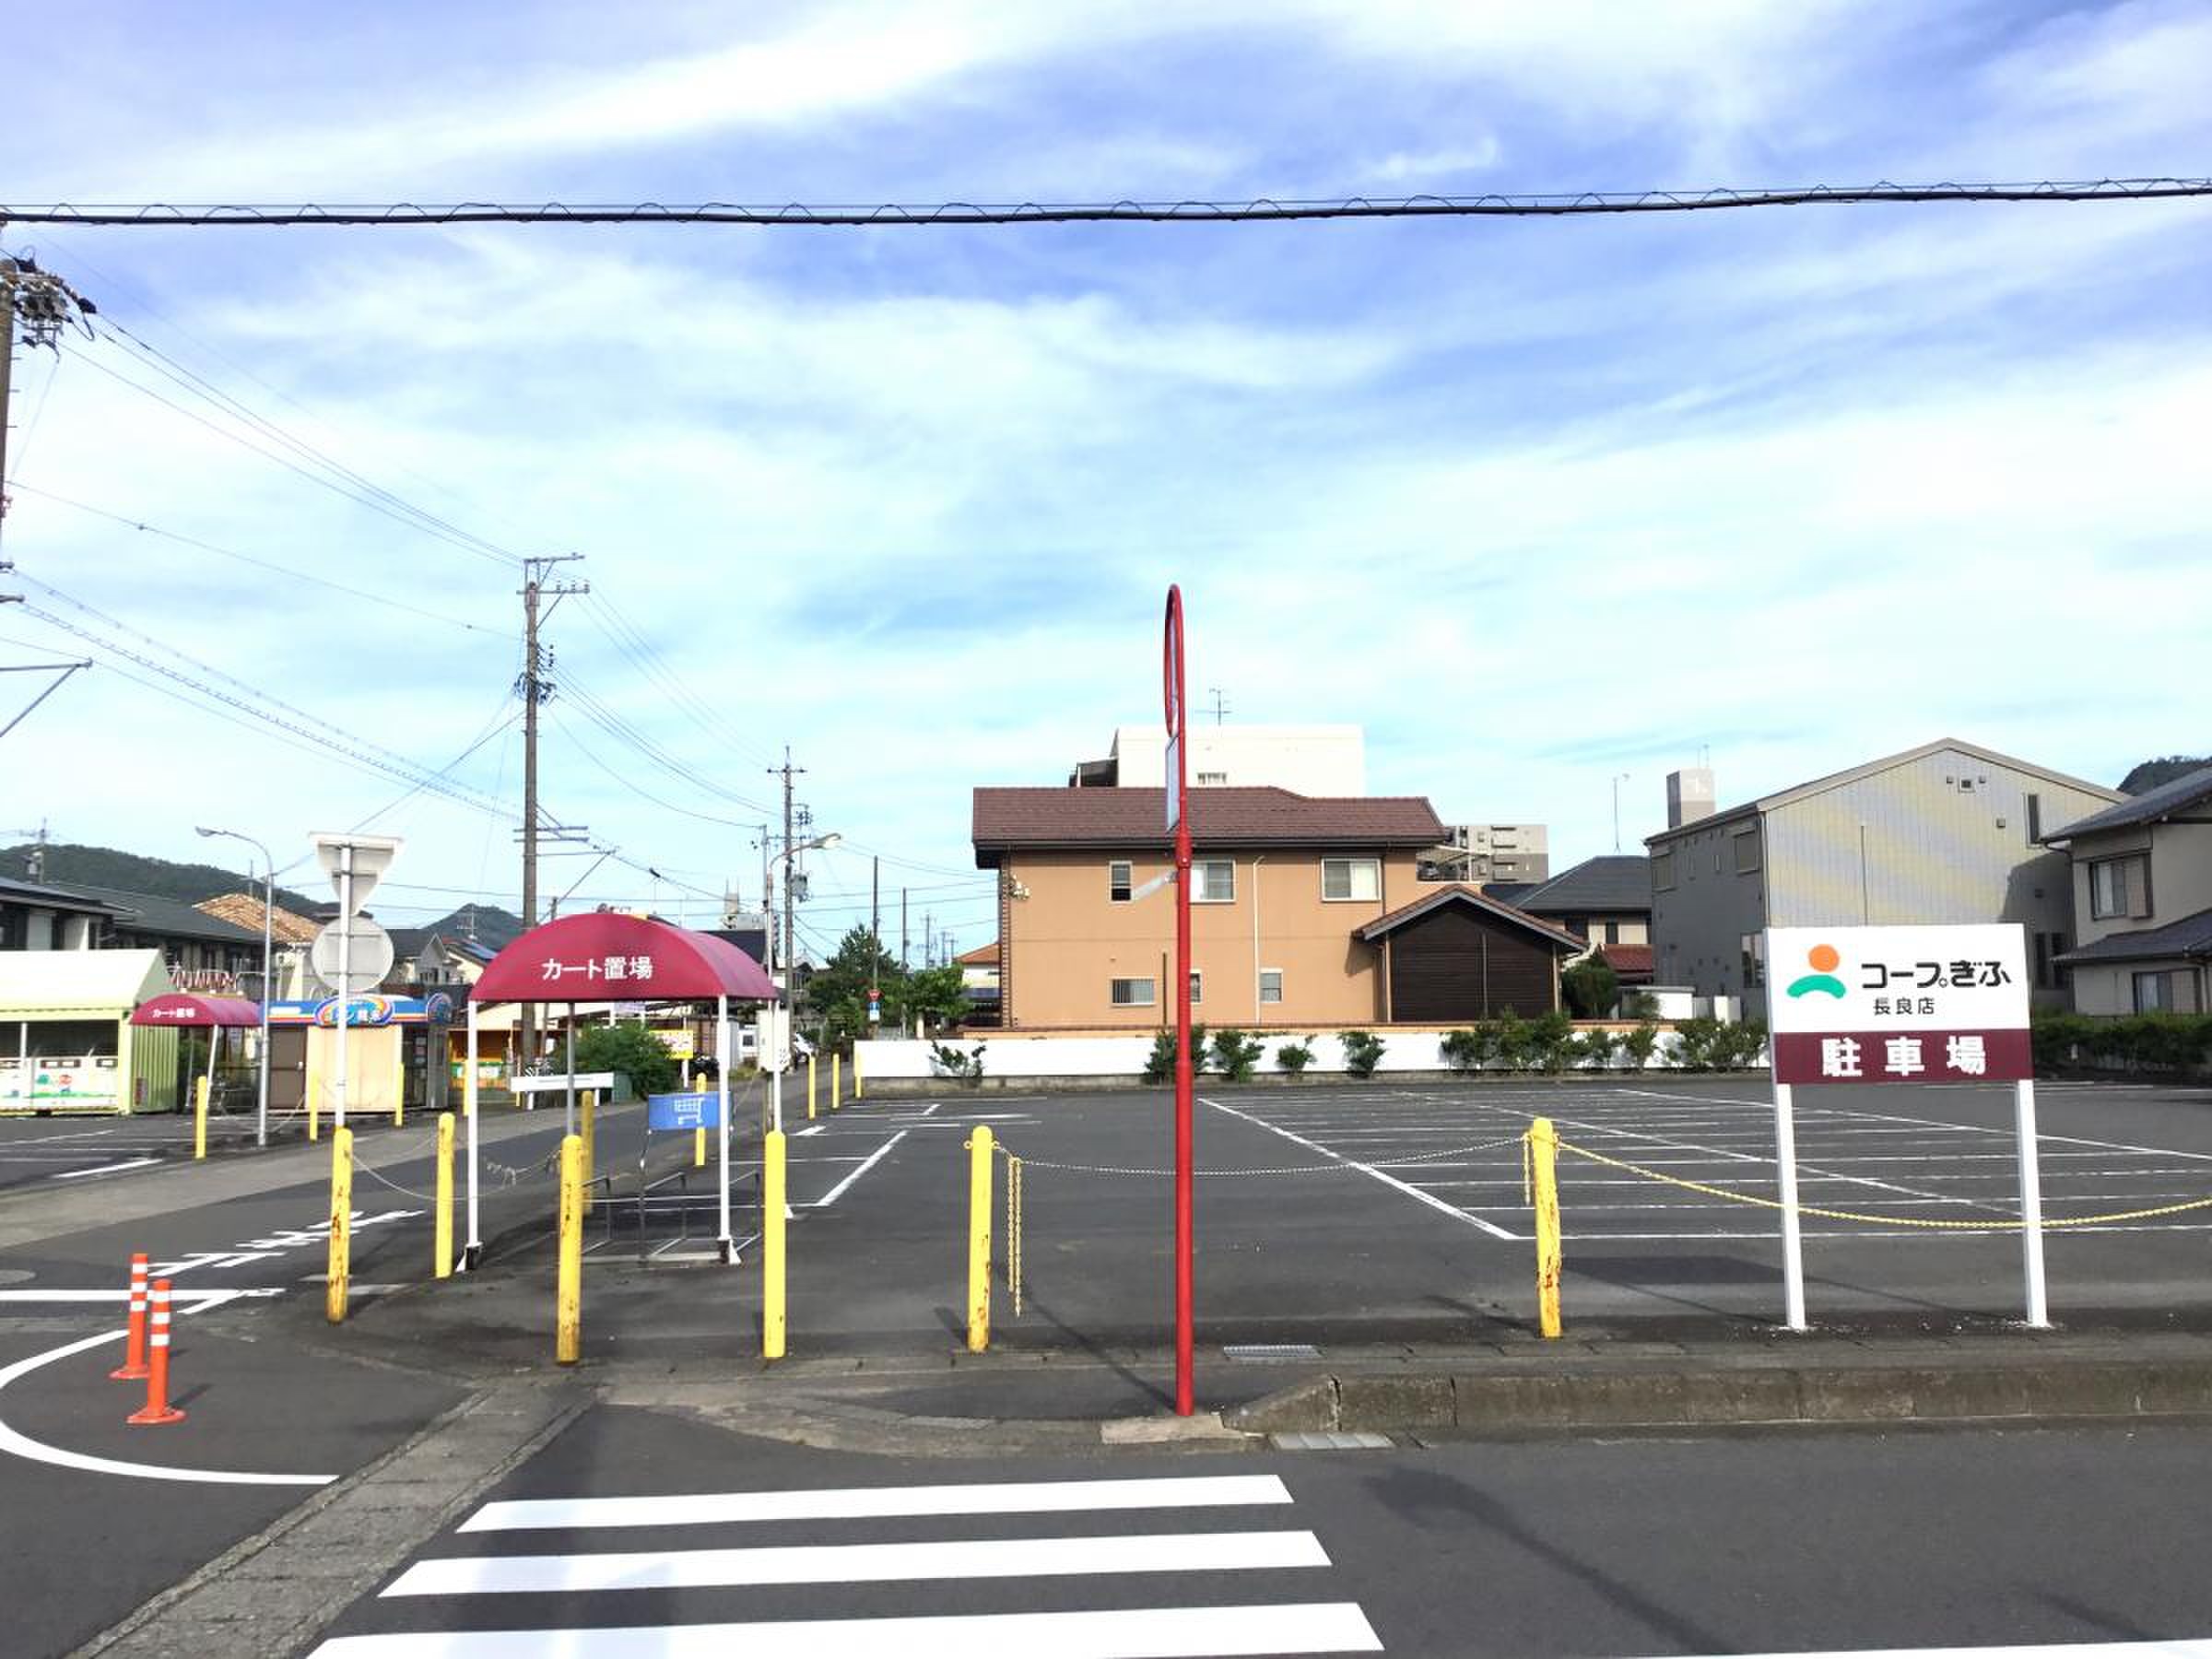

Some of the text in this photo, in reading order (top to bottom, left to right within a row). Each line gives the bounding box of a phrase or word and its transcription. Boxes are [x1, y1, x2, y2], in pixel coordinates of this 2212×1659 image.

[541, 956, 653, 980] カート置場
[1873, 997, 1936, 1016] 長良店
[1821, 1035, 1986, 1077] 駐車場
